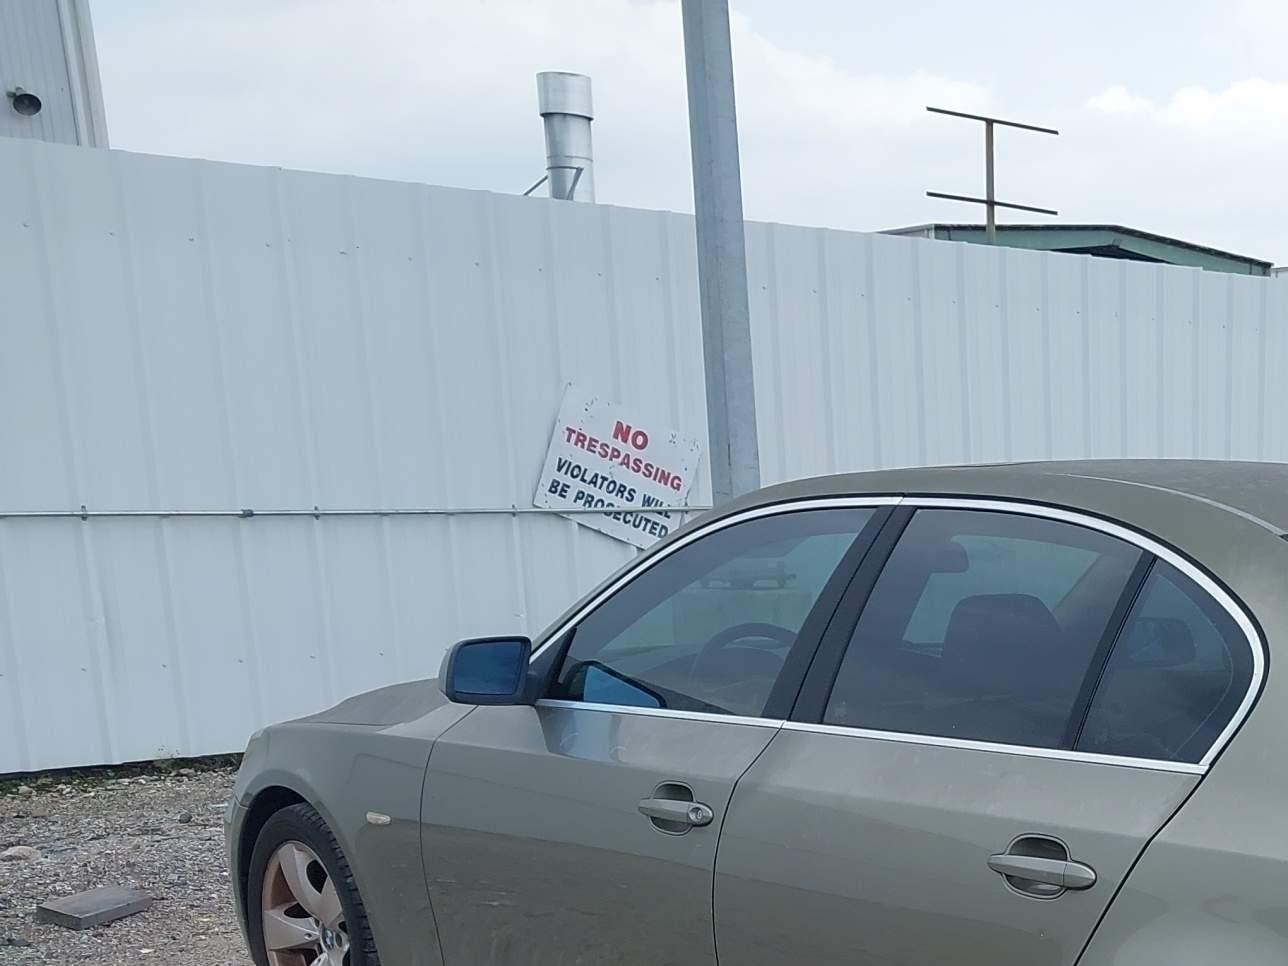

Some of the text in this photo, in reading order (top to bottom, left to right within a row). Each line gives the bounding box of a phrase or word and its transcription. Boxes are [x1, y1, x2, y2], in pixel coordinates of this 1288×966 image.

[612, 420, 649, 450] NO
[565, 427, 682, 491] TRESPASSING
[548, 478, 571, 499] BE
[556, 457, 636, 503] VIOLATORS
